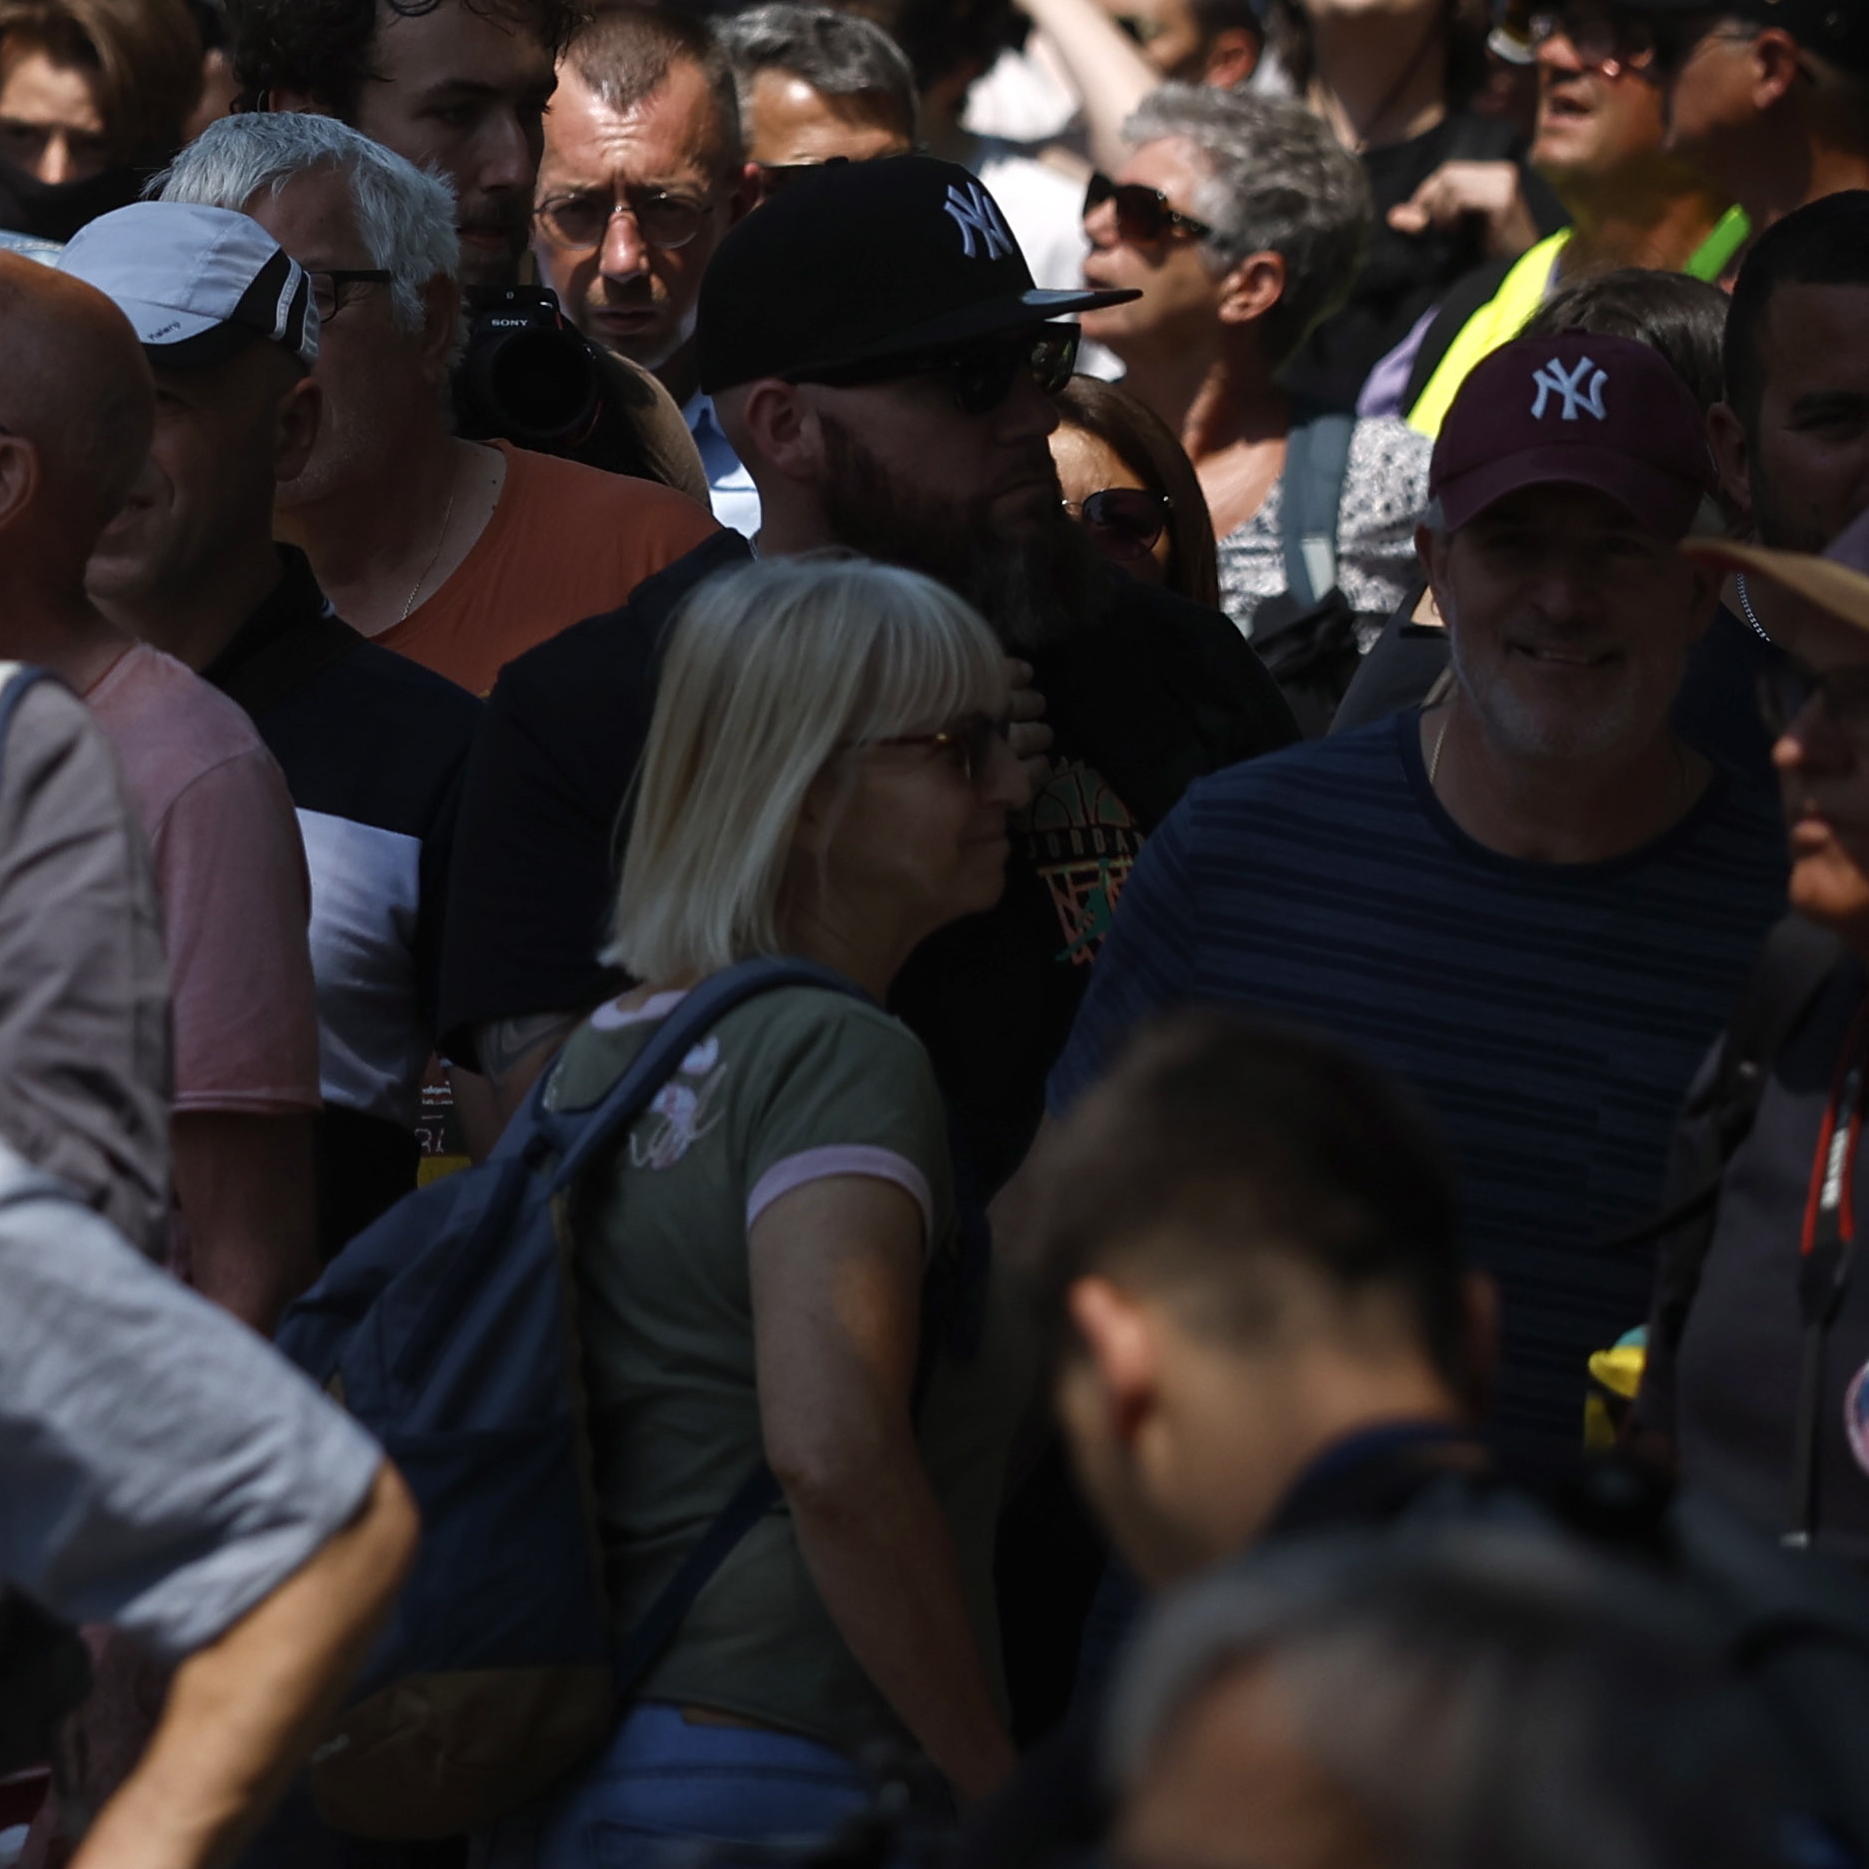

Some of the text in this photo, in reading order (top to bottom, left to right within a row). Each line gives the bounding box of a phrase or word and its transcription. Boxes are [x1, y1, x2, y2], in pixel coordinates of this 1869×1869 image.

[944, 181, 1013, 260] NY
[491, 318, 529, 327] SONY
[1530, 355, 1609, 421] NY
